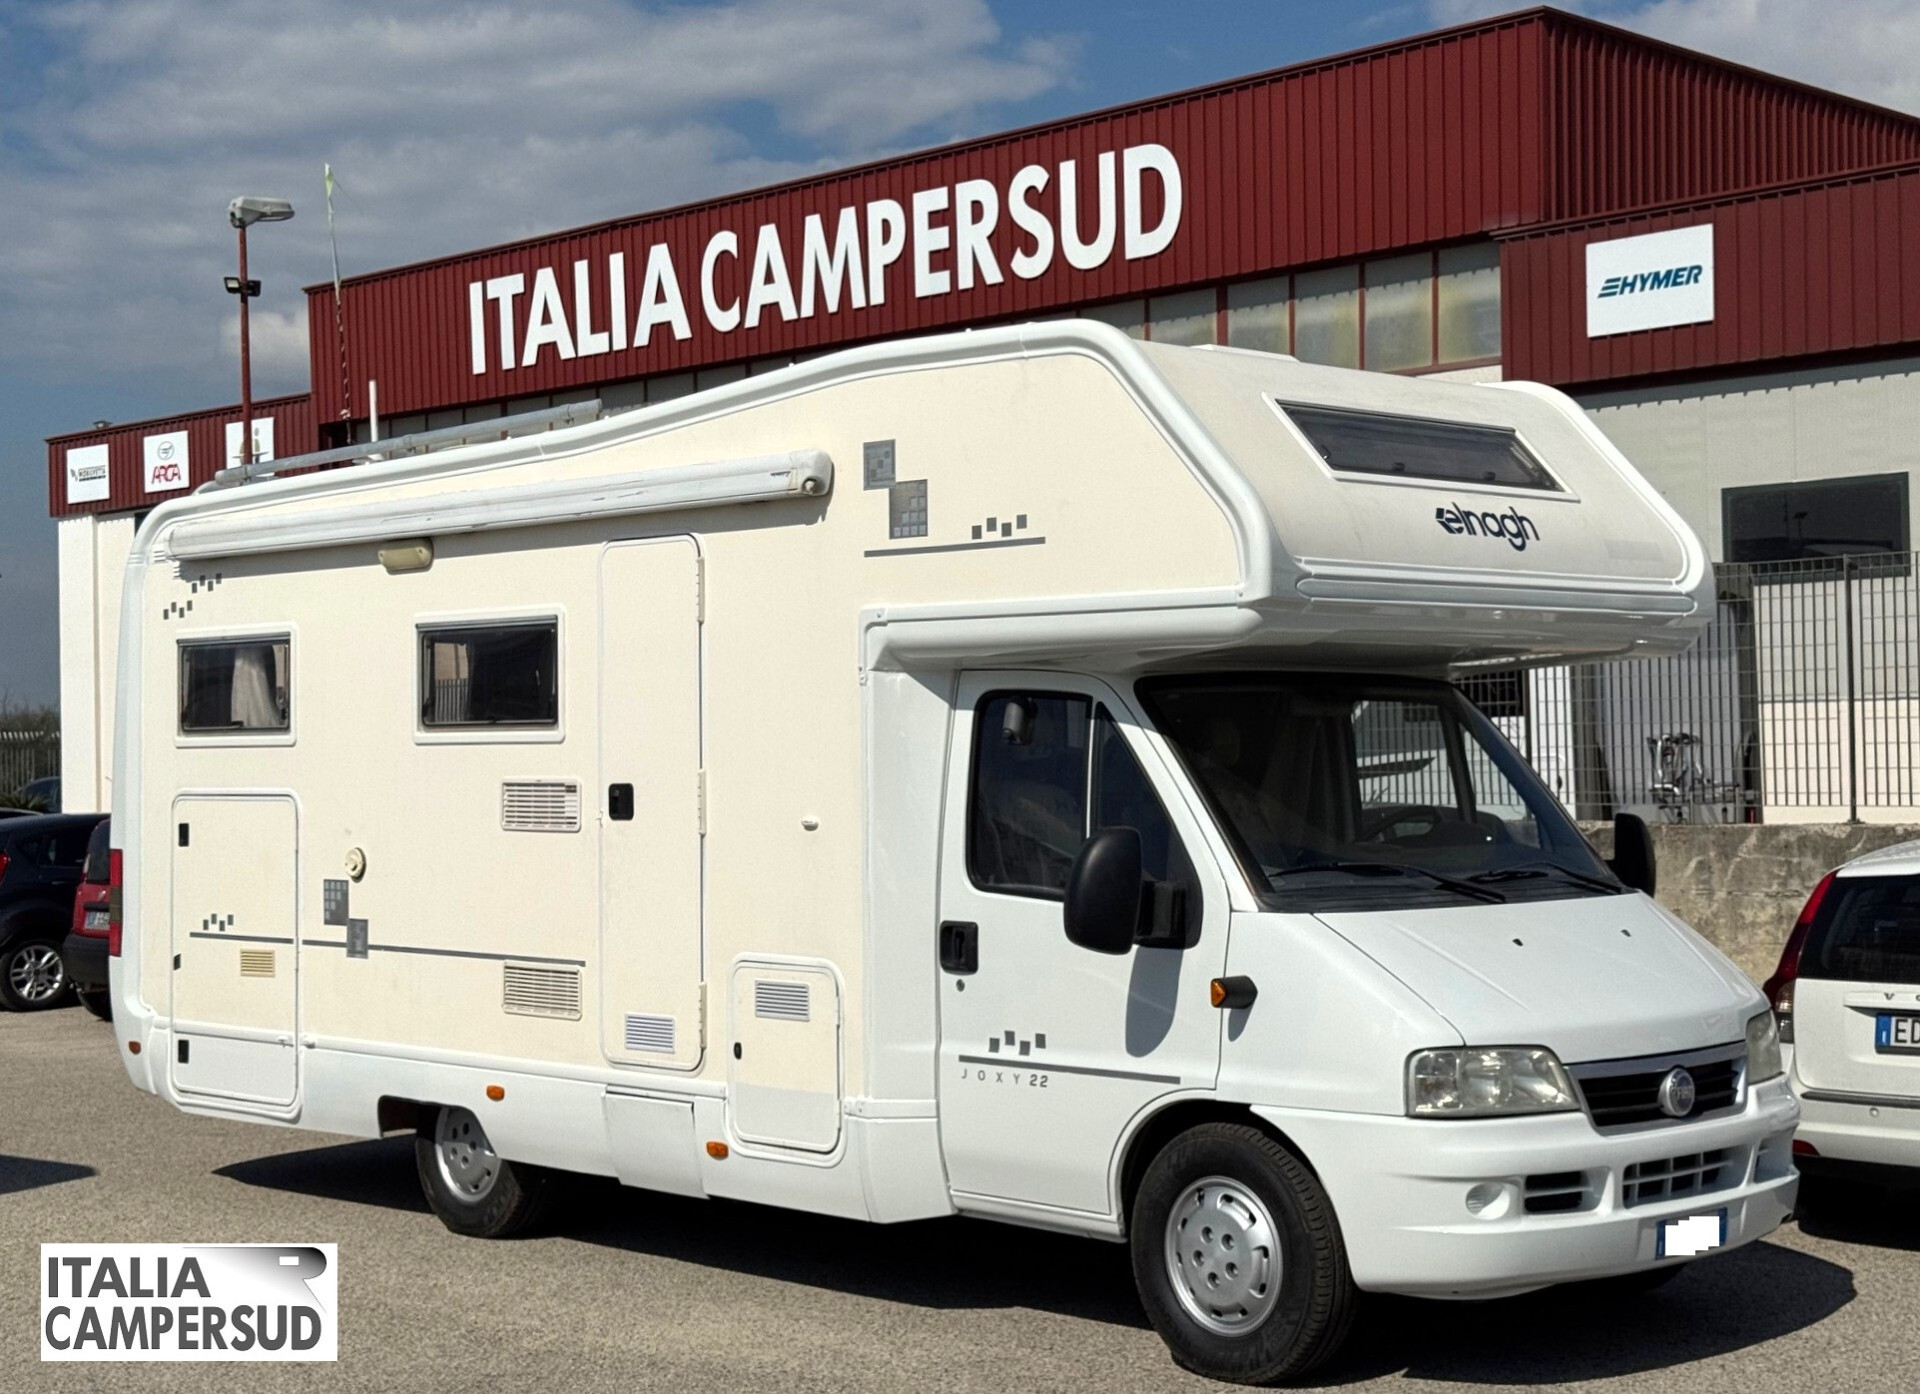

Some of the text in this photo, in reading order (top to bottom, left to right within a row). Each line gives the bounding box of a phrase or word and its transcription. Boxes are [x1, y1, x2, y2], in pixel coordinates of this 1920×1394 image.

[468, 143, 1183, 375] ITALIA CAMPERSUD
[151, 463, 181, 484] ARCA
[1437, 501, 1540, 552] elnagh
[1029, 1073, 1048, 1087] 22
